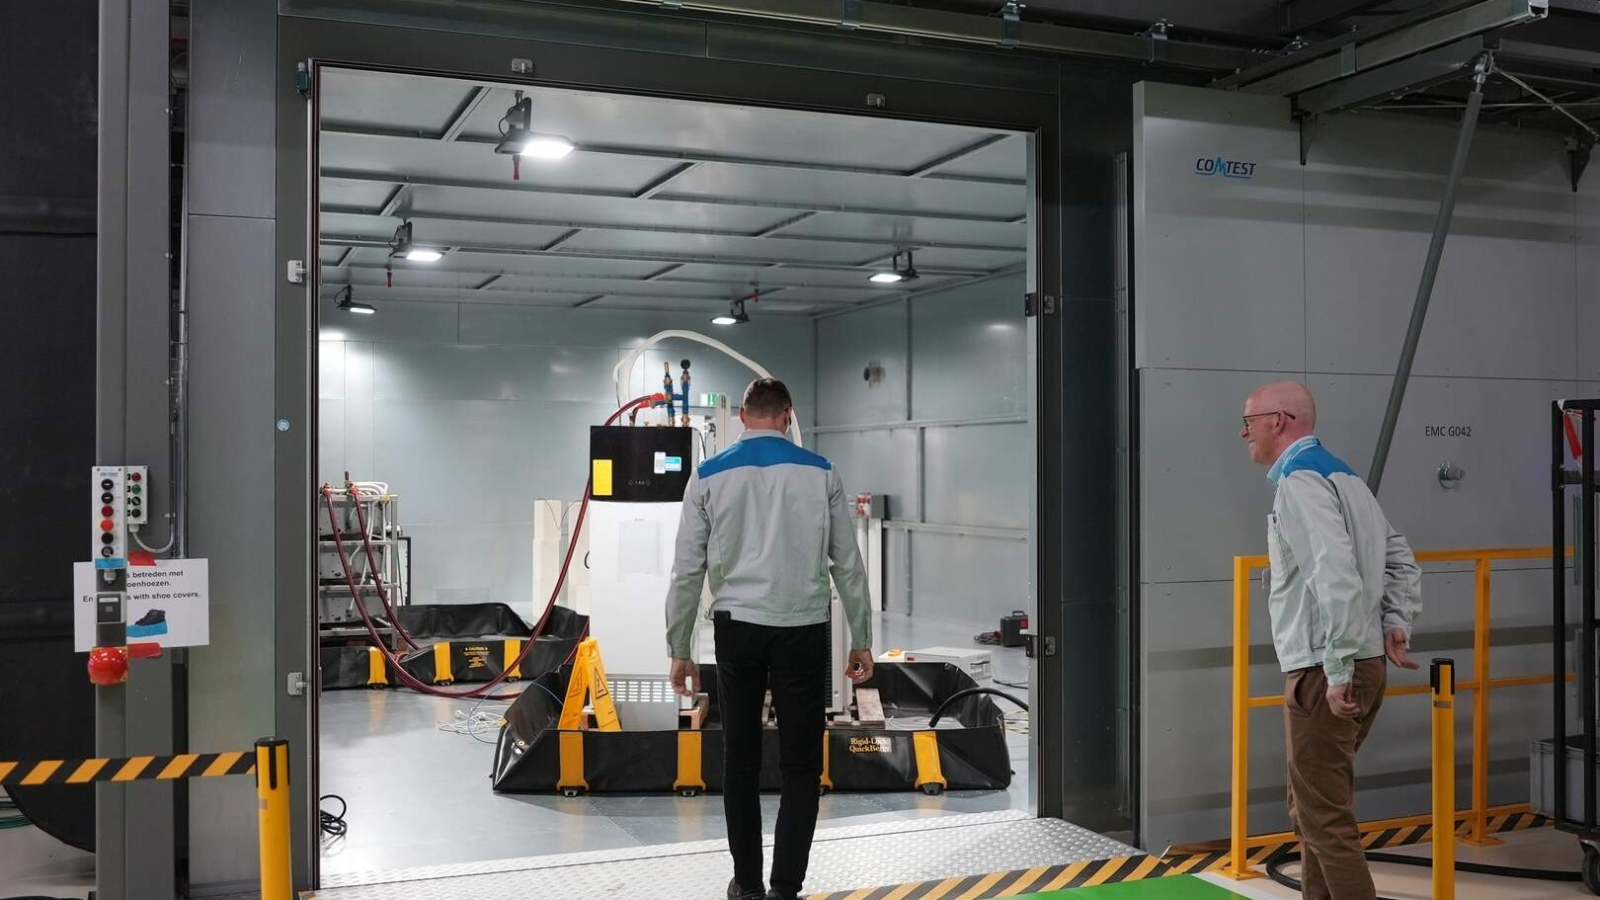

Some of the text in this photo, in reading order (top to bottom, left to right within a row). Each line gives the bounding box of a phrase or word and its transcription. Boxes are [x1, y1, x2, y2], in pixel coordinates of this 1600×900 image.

[1195, 156, 1257, 179] COMTEST
[1425, 425, 1472, 437] EMC G042
[126, 580, 172, 588] oenhoezen.
[151, 592, 171, 600] shoe
[172, 591, 201, 599] covers.
